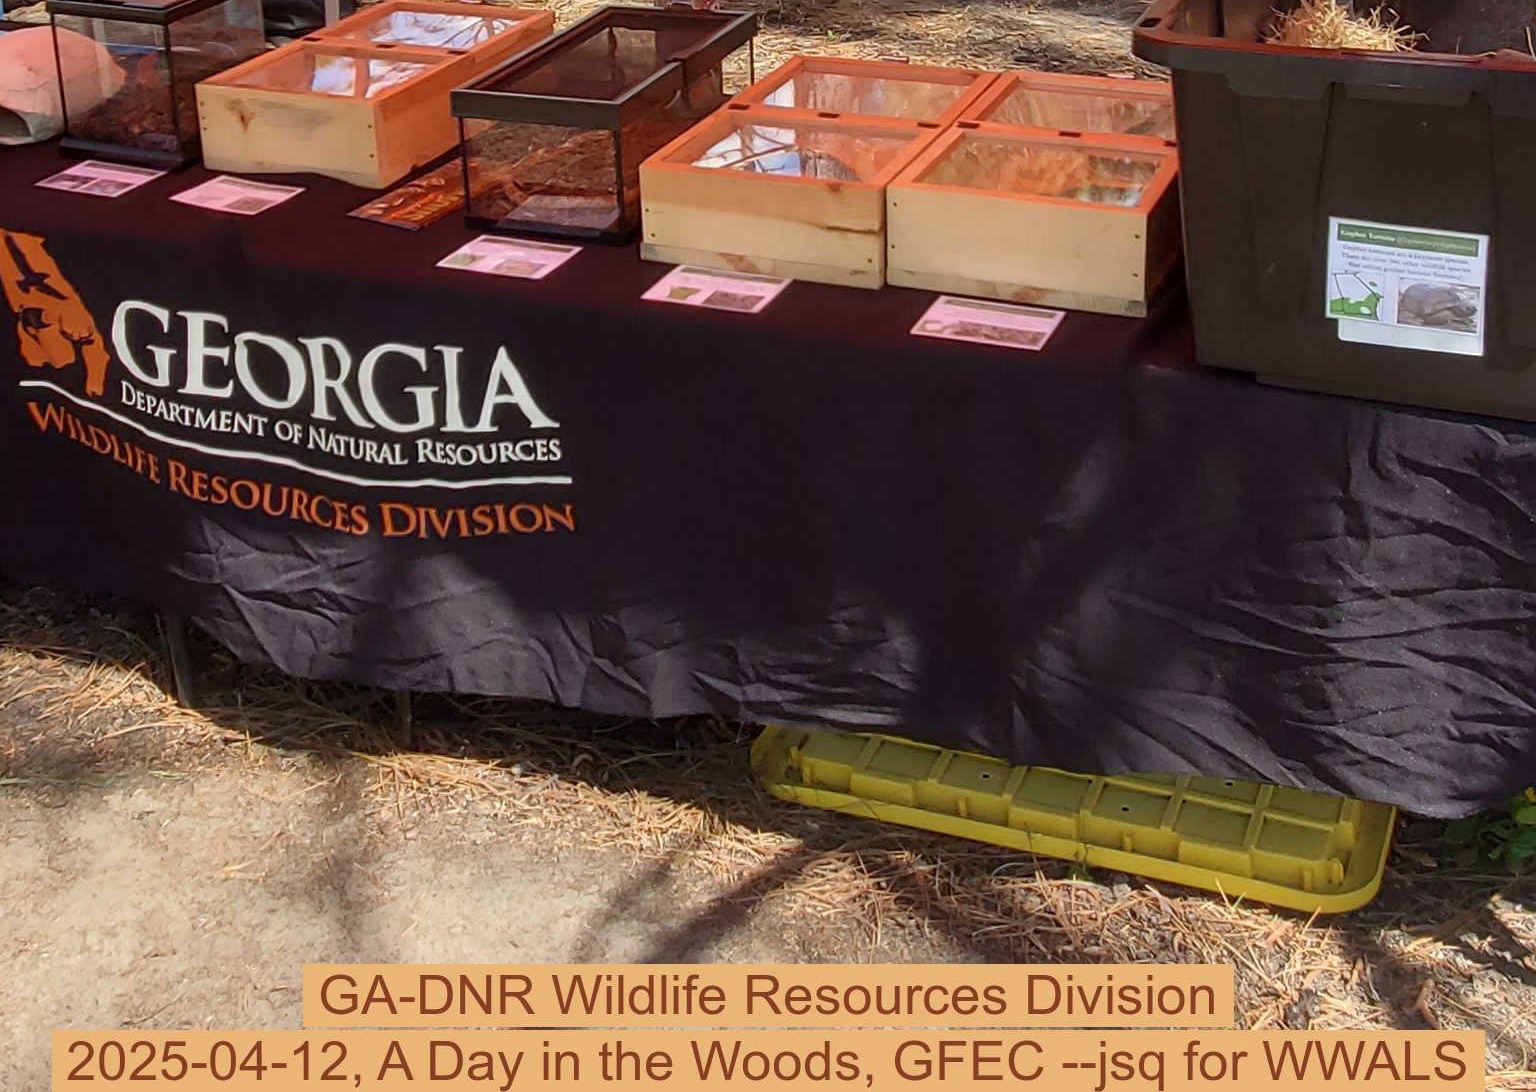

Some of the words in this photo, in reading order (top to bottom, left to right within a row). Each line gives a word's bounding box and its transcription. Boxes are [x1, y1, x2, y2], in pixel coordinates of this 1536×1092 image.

[111, 299, 561, 433] GEORGIA
[120, 380, 269, 437] DEPARTMENT
[273, 419, 303, 445] OF
[306, 426, 409, 466] NATURAL
[414, 438, 562, 466] RESOURCES
[26, 401, 161, 485] WILDLIFE
[167, 458, 370, 536] RESOURCES
[378, 502, 576, 540] DIVISION
